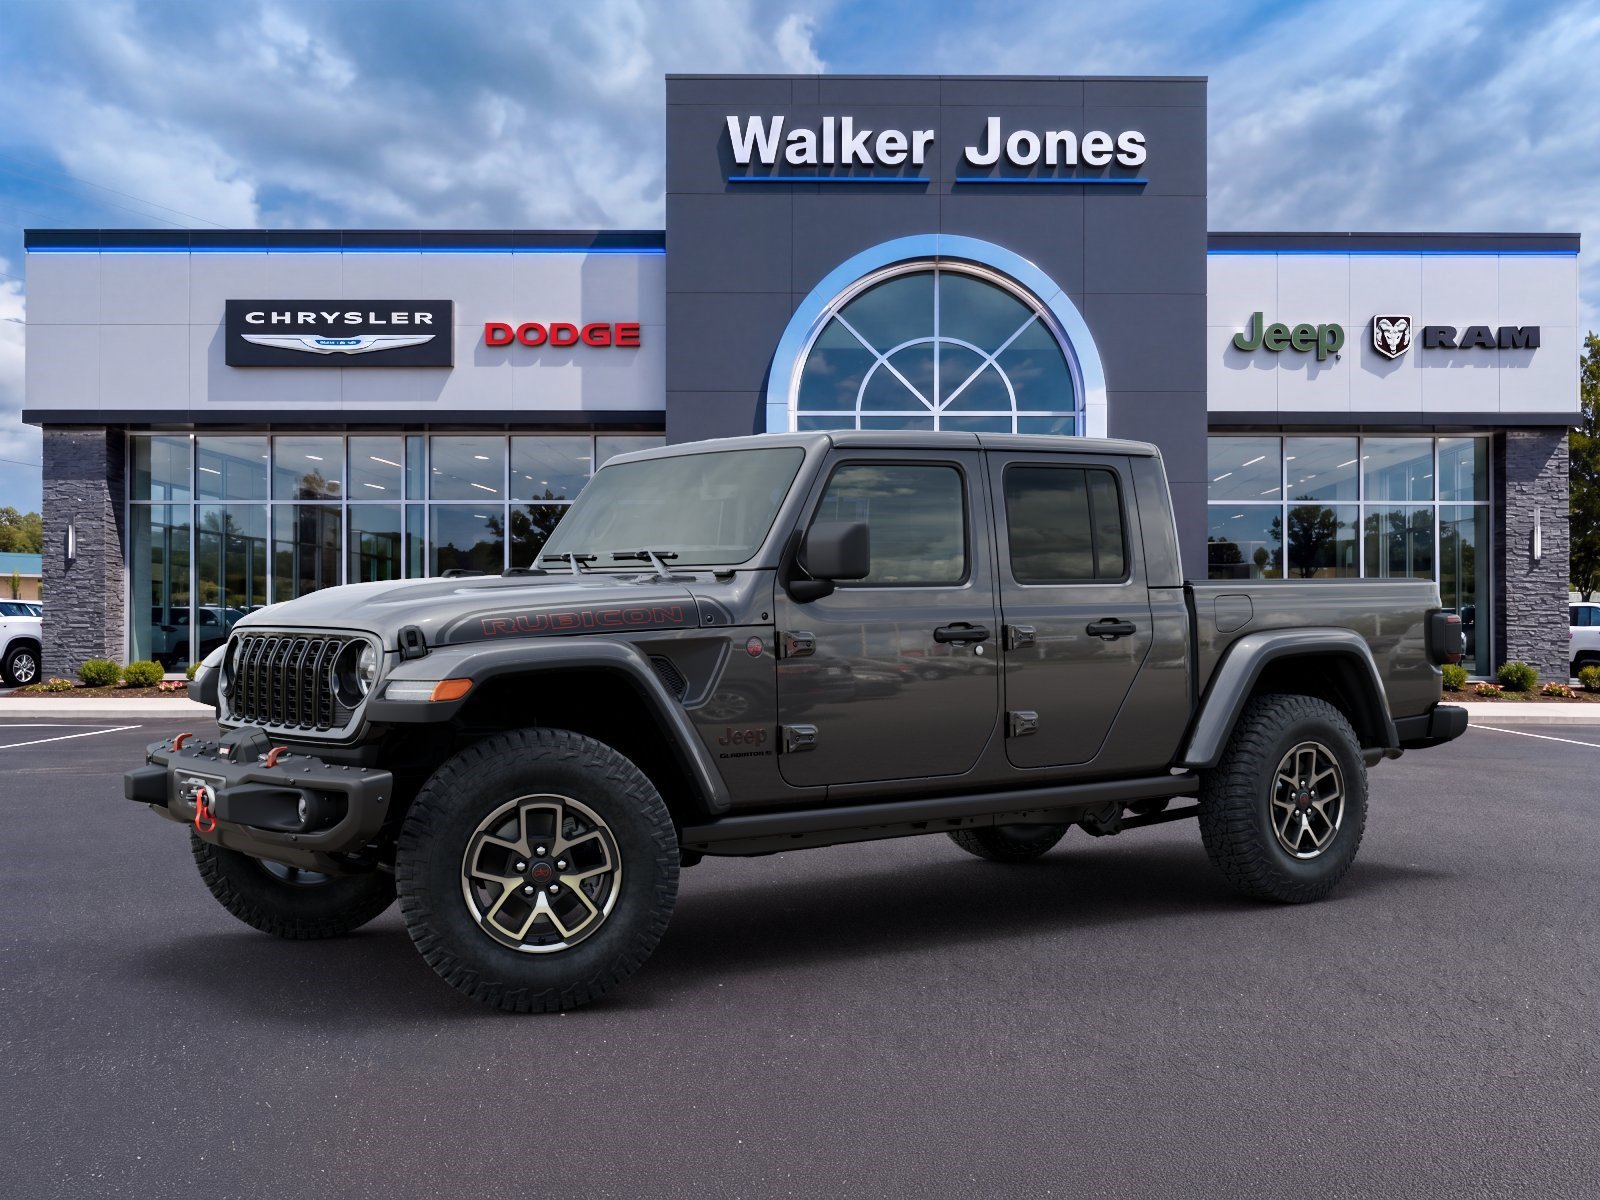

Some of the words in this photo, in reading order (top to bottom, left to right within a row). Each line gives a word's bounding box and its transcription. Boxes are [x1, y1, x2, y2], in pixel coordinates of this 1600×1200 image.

[726, 115, 934, 166] Walker
[964, 116, 1147, 166] Jones
[245, 311, 434, 325] CHRYSLER
[484, 322, 641, 347] DODGE
[1233, 311, 1345, 361] Jeep
[1423, 325, 1541, 348] RAM
[481, 606, 684, 635] RUBICON
[717, 726, 768, 747] Jeep
